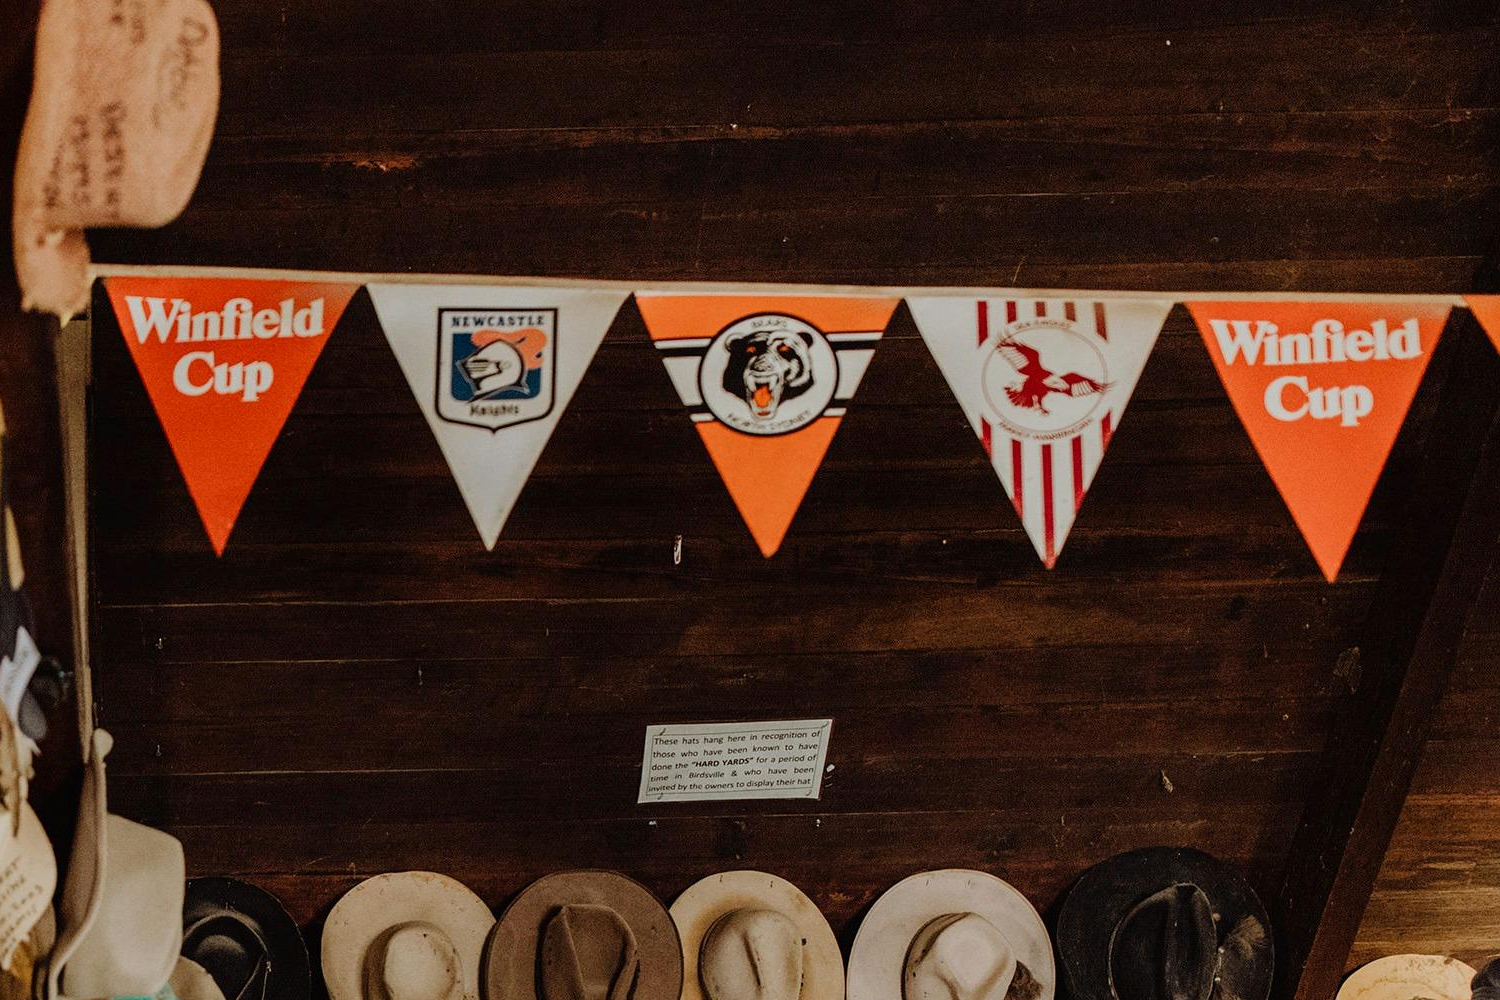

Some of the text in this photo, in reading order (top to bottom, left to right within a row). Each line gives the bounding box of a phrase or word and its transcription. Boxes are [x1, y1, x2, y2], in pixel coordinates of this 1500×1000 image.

[124, 295, 325, 346] Winfield
[451, 315, 546, 328] NEWCASTLE
[1210, 318, 1424, 367] Winfield
[172, 351, 274, 402] Cup
[1264, 375, 1375, 427] Cup
[469, 402, 521, 418] Knights
[654, 730, 821, 746] These hats hang here in recognition of
[653, 750, 676, 758] those
[703, 748, 723, 756] have
[727, 746, 748, 755] been
[752, 744, 780, 752] known
[798, 742, 818, 750] have
[651, 763, 672, 771] done
[675, 761, 689, 769] the
[756, 756, 768, 764] for
[778, 754, 805, 764] period
[807, 753, 818, 761] of
[650, 774, 669, 782] time
[688, 770, 725, 779] Birdsville
[731, 769, 738, 777] &
[744, 768, 762, 776] who
[767, 767, 788, 775] have
[793, 765, 814, 774] been
[648, 777, 812, 792] invited by the owners to display their hat
